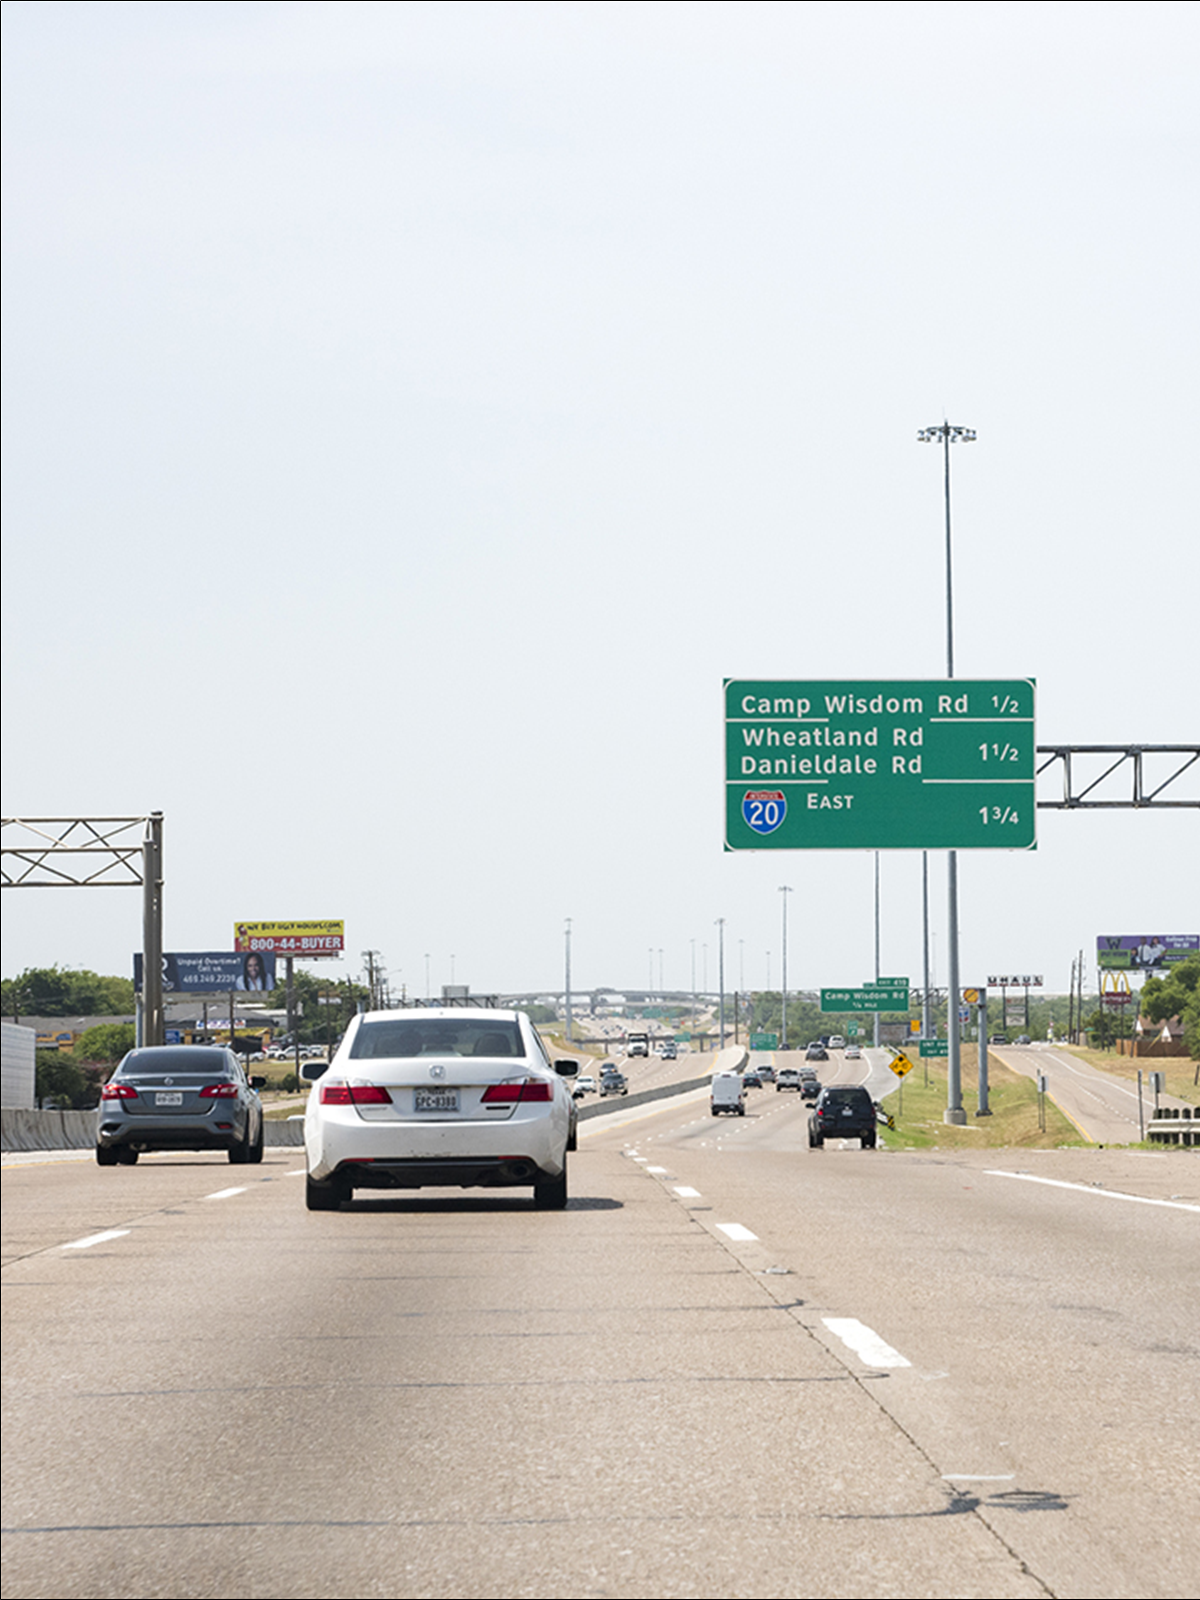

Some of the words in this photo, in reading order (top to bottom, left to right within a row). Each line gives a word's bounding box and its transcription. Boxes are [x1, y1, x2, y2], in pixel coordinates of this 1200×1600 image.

[742, 695, 811, 718] Camp
[824, 694, 923, 713] Wisdom
[938, 694, 968, 713] Rd
[991, 695, 1019, 713] 1/2
[742, 727, 878, 747] Wheatland
[893, 727, 923, 747] Rd
[741, 754, 877, 774] Danieldale
[892, 754, 922, 774] Rd
[807, 793, 854, 810] EAST
[750, 801, 779, 825] 20
[250, 937, 341, 950] 800-44-BUYER
[825, 992, 850, 1001] Camp
[853, 991, 888, 1000] Wisdom
[892, 991, 905, 1000] Rd
